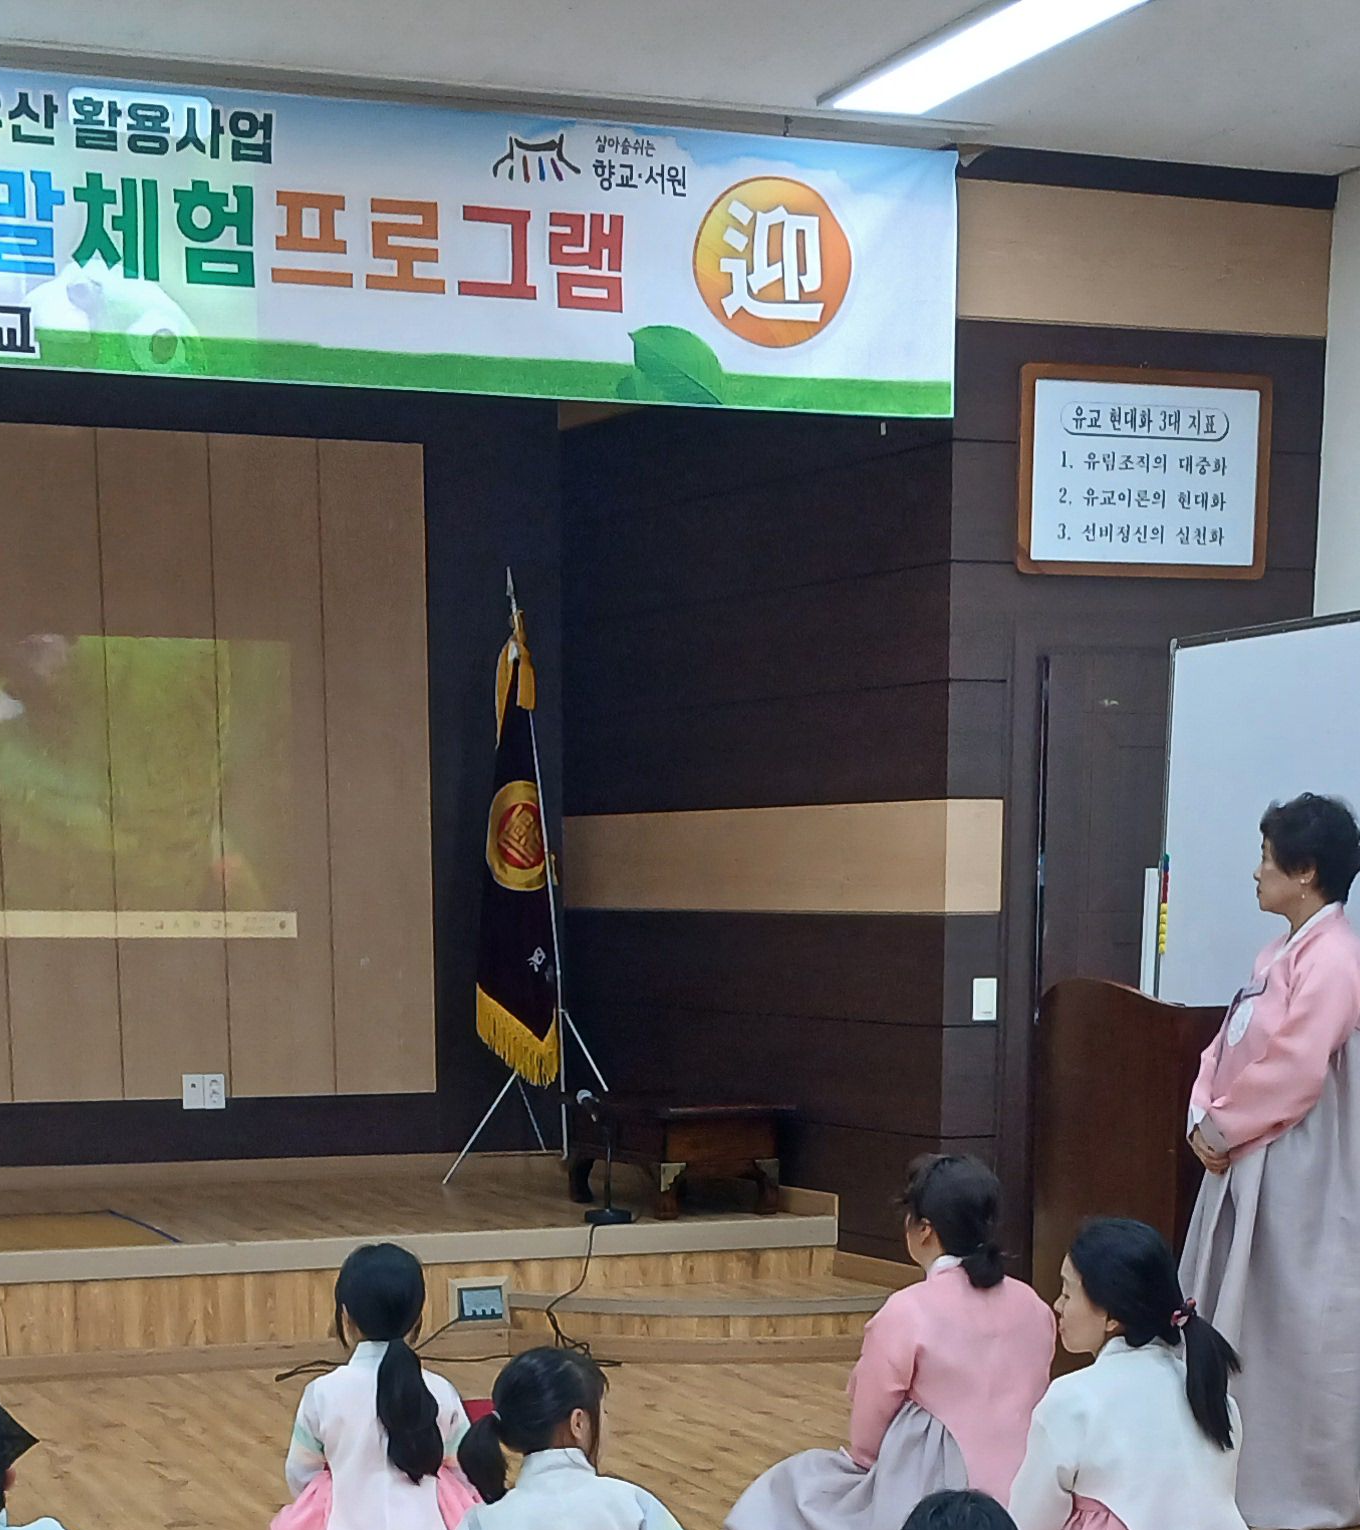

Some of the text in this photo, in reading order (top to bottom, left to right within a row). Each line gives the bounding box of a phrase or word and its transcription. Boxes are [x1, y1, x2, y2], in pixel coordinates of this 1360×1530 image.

[72, 96, 274, 164] 활용사업
[592, 159, 687, 197] 향교·서원
[718, 200, 825, 325] 迎
[1072, 406, 1217, 436] 유교 현대화 3대 지표
[1061, 450, 1228, 477] 1. 유림조직의 대중화
[1058, 487, 1227, 512] 2. 유교이론의 현대화
[1057, 523, 1071, 541] 3.
[1081, 523, 1165, 544] 선비정신의
